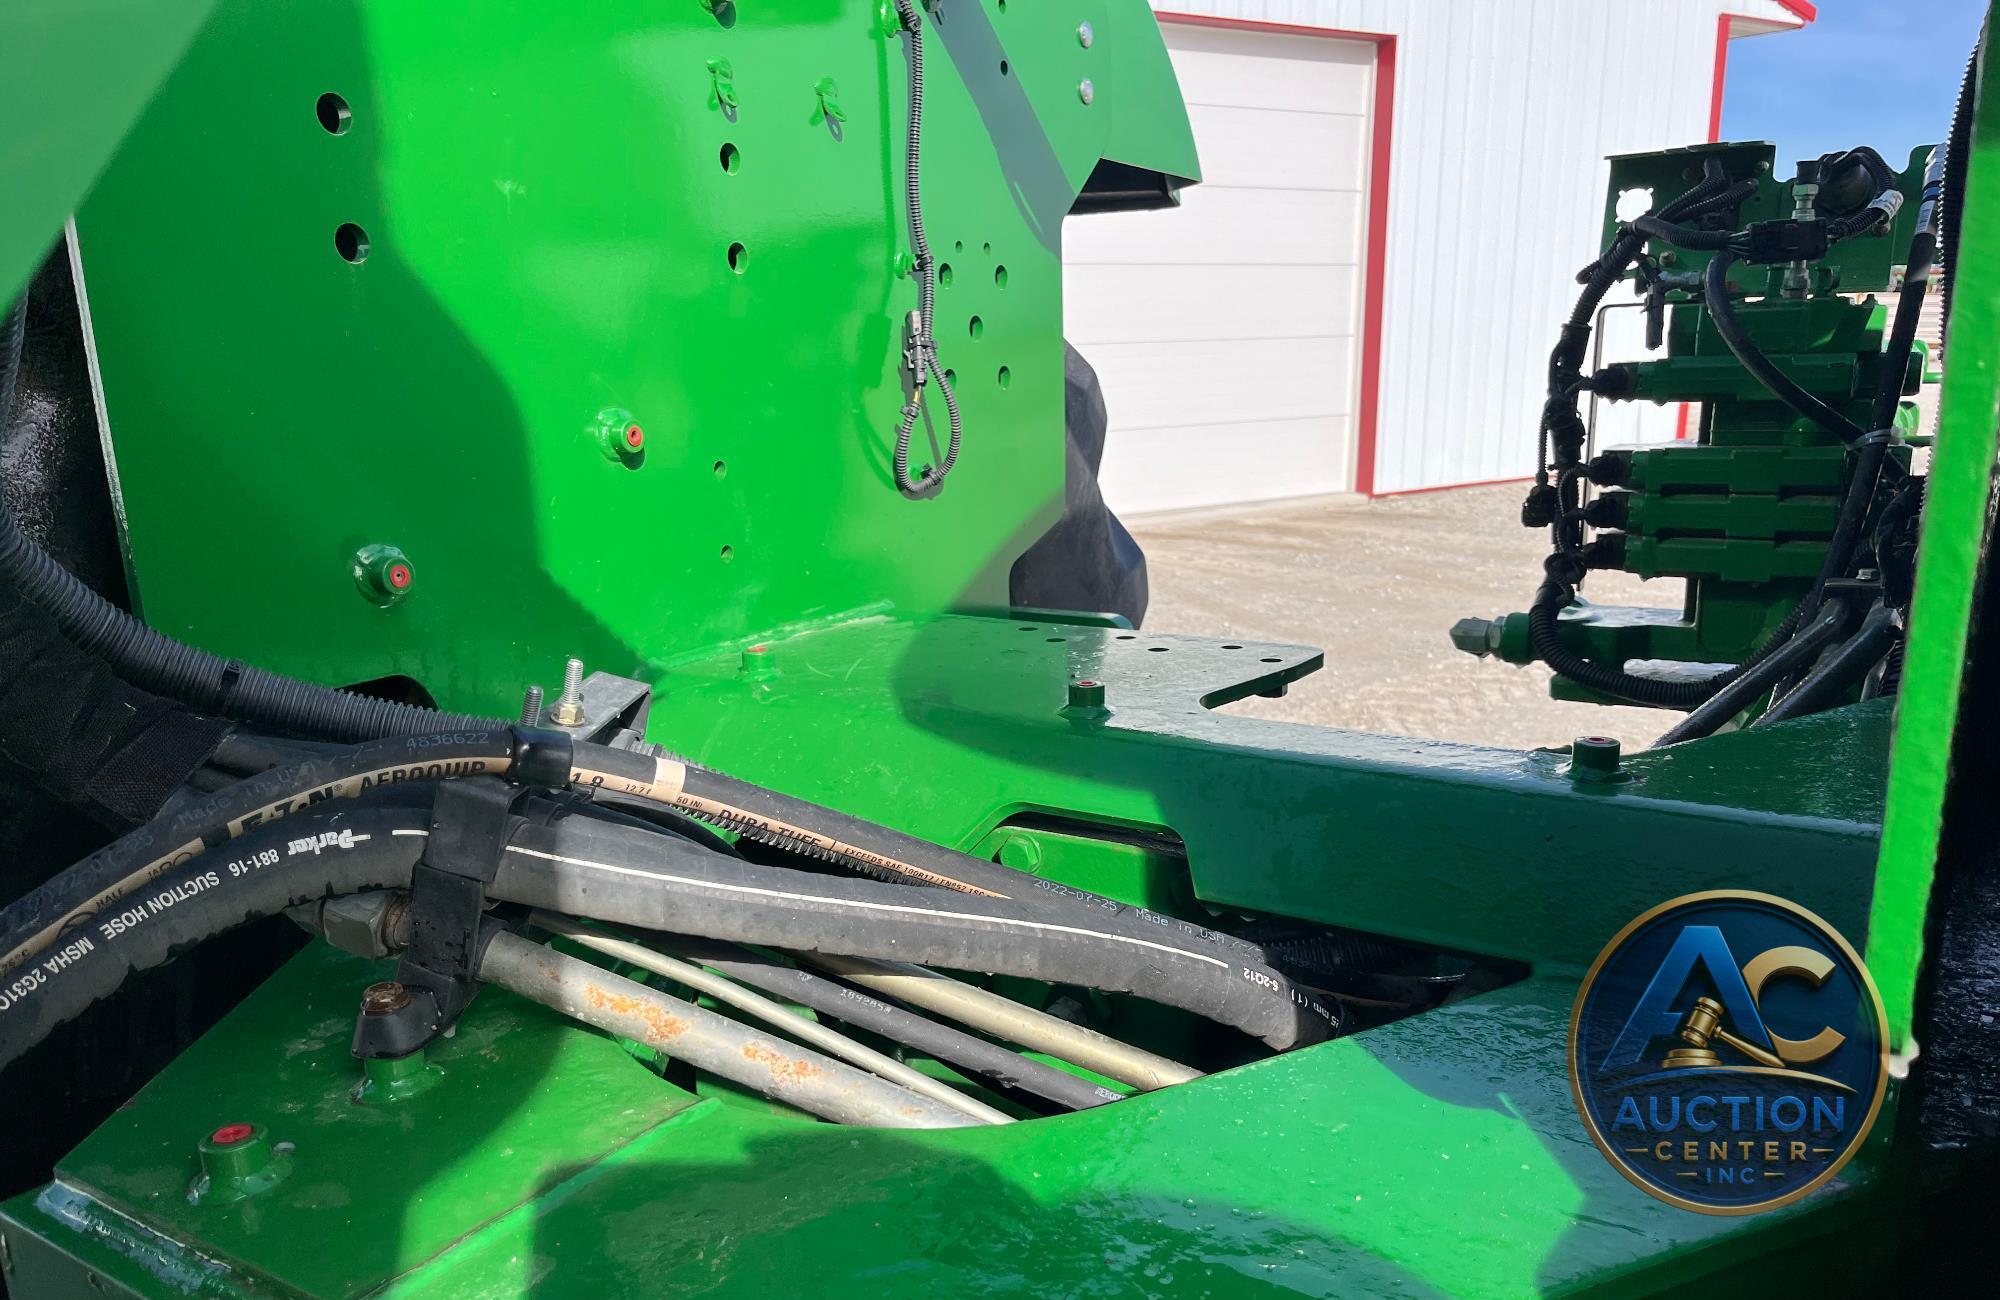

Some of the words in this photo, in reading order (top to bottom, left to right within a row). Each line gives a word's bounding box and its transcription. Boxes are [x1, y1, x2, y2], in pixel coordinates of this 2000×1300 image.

[406, 732, 489, 749] 4836622
[288, 829, 371, 856] Parker
[845, 847, 883, 865] EXCEEDS
[229, 849, 280, 877] 881-16
[147, 871, 220, 915] SUCTION
[99, 905, 149, 940] HOSE
[1034, 878, 1117, 911] 2022-07-25
[1136, 908, 1169, 927] Made
[1179, 922, 1192, 935] in
[1200, 925, 1225, 944] USA
[43, 937, 95, 974] MSHA
